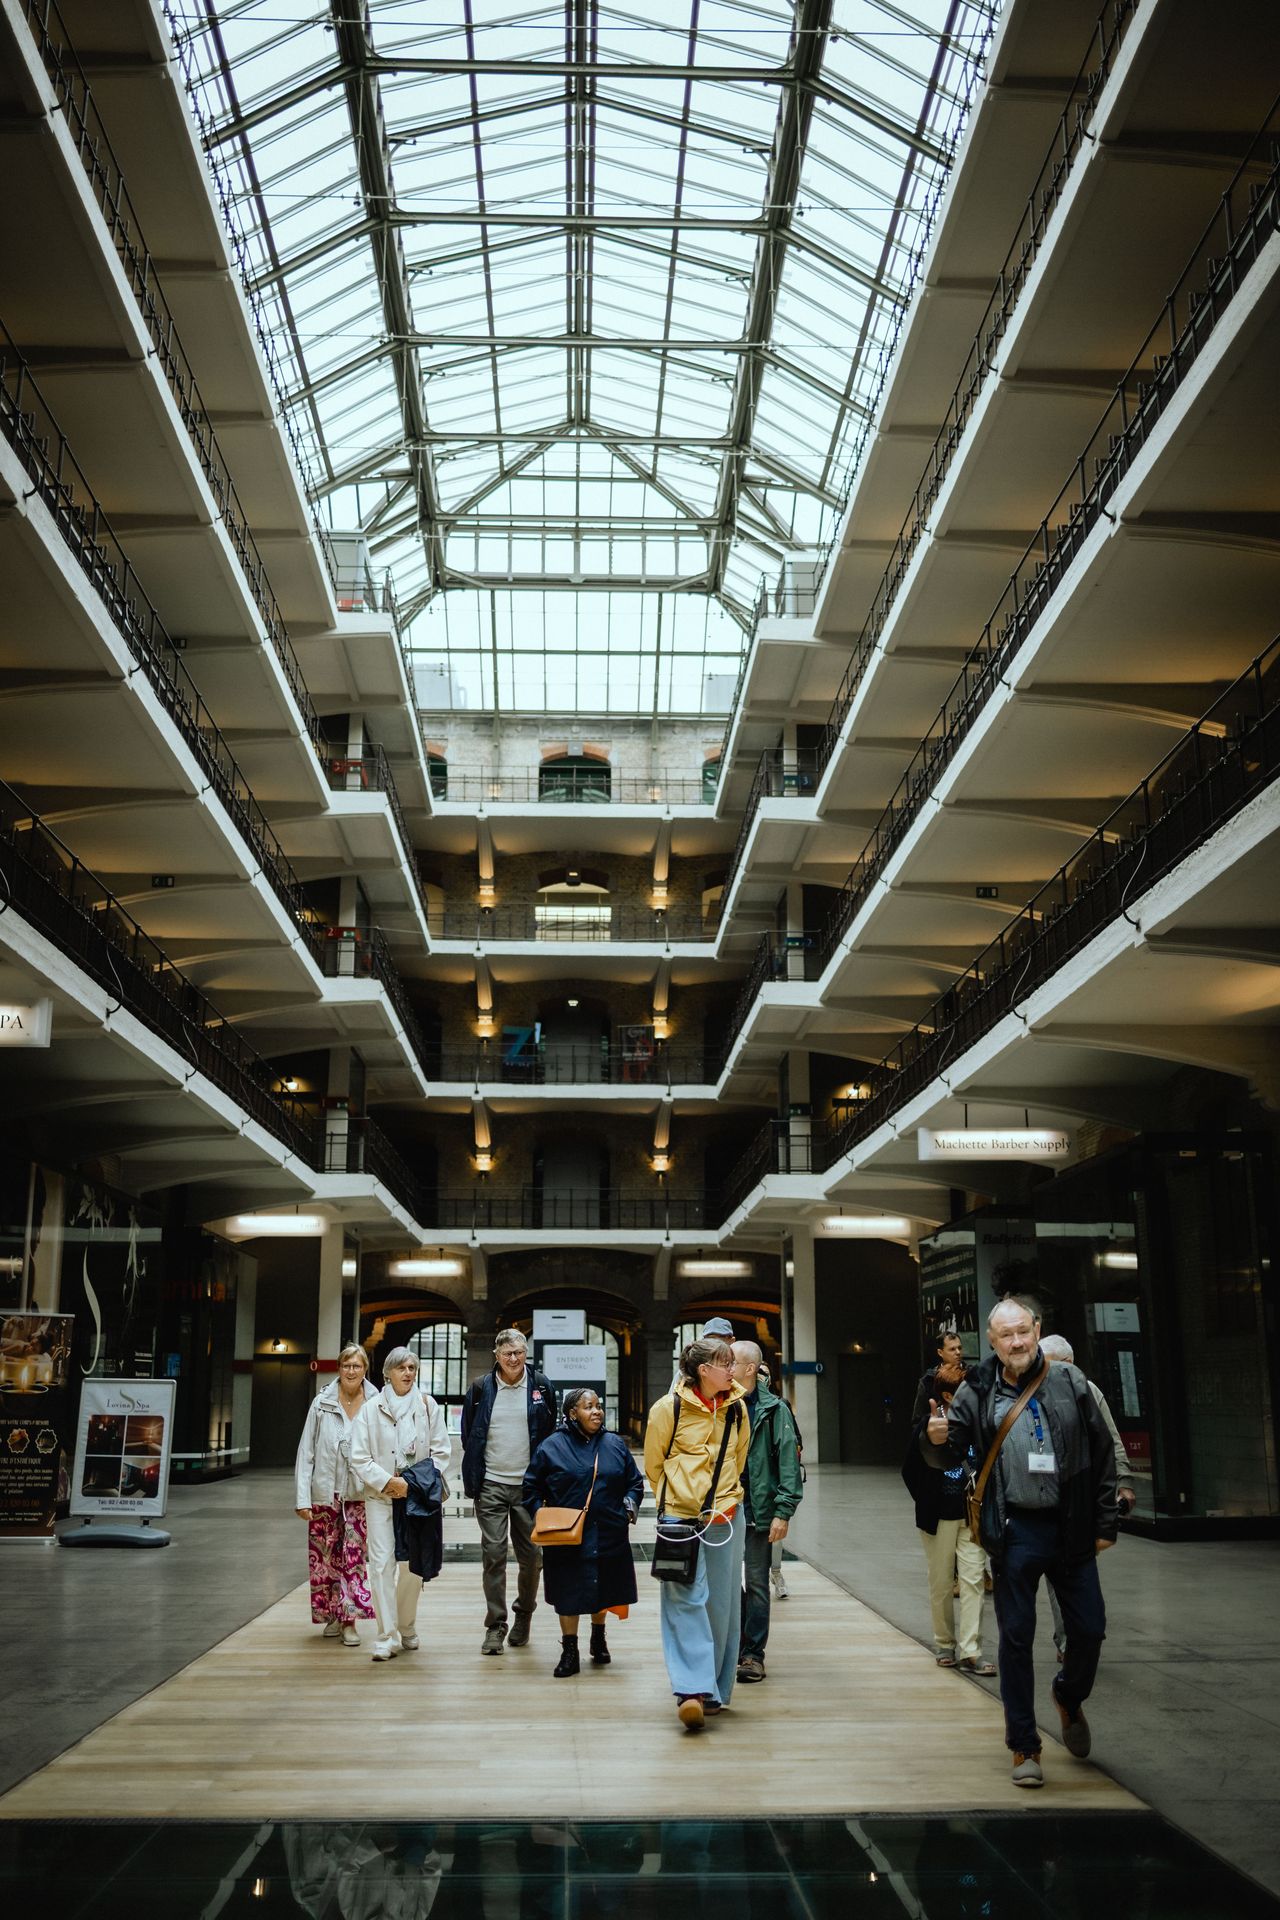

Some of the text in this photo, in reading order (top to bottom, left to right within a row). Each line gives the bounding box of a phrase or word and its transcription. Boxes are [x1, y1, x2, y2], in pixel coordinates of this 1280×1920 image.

[935, 1138, 1071, 1152] Machette Barber Supply
[556, 1355, 594, 1363] ENTREPÔT
[310, 1361, 318, 1371] 0
[815, 1363, 823, 1373] 0
[136, 1399, 150, 1410] Spa
